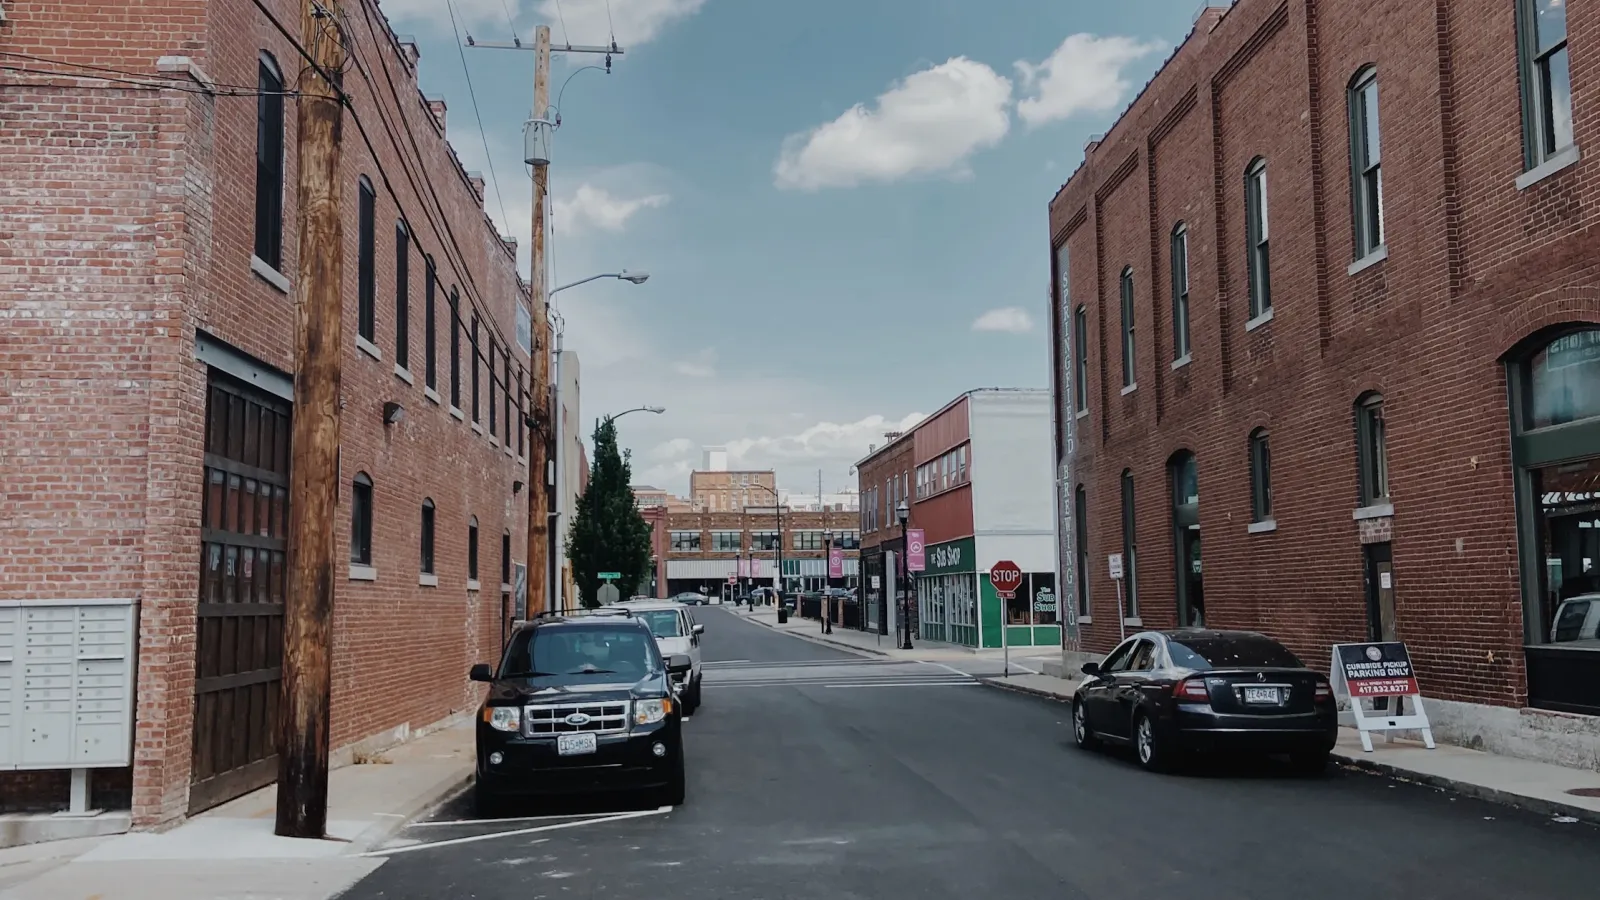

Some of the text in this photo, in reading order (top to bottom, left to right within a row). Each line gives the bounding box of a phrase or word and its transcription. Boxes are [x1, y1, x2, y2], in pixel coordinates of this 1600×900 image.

[1062, 271, 1073, 454] SPRINGFIELD
[1063, 465, 1073, 585] BREWING
[947, 545, 961, 567] SHOP
[992, 570, 1019, 582] STOP
[1346, 662, 1382, 670] CURBSIDE
[1348, 668, 1409, 678] PARKING ONLY
